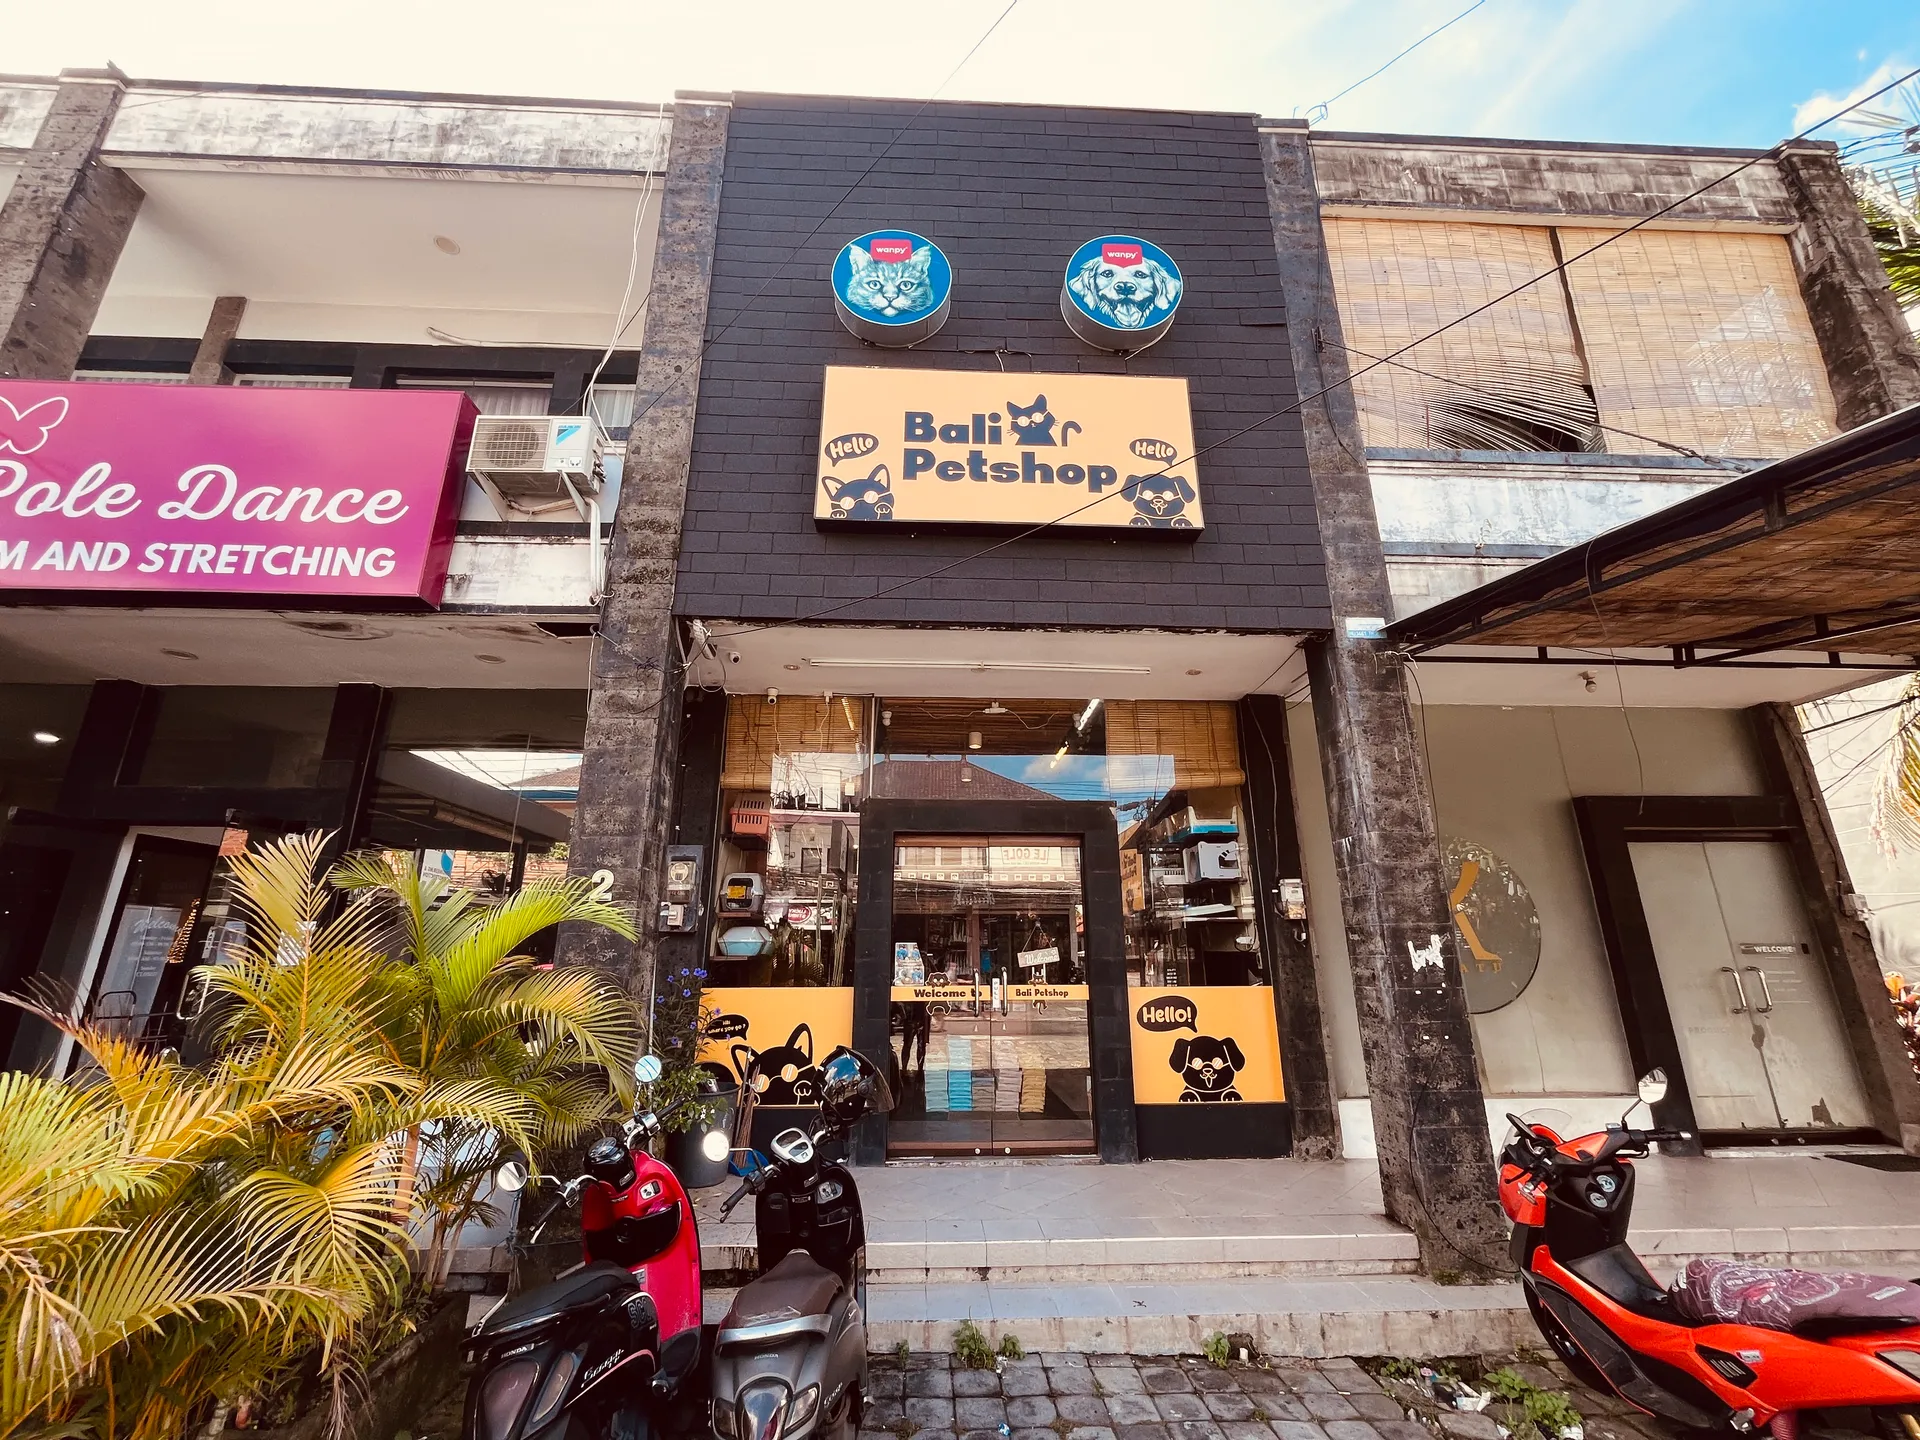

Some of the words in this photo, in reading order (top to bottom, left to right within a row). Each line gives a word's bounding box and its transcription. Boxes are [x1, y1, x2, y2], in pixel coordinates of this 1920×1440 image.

[1107, 251, 1137, 259] wanpy
[904, 411, 1002, 445] Bali
[829, 435, 874, 459] Hello
[1134, 440, 1175, 459] Hello
[902, 448, 1118, 494] Petshop
[158, 464, 409, 524] Dance
[31, 541, 131, 572] AND
[137, 542, 397, 578] STRETCHING
[590, 869, 614, 901] 2
[914, 989, 966, 998] Welcome
[1015, 988, 1032, 997] Bali
[1035, 988, 1069, 998] Petshop
[1142, 1006, 1192, 1023] Hello!
